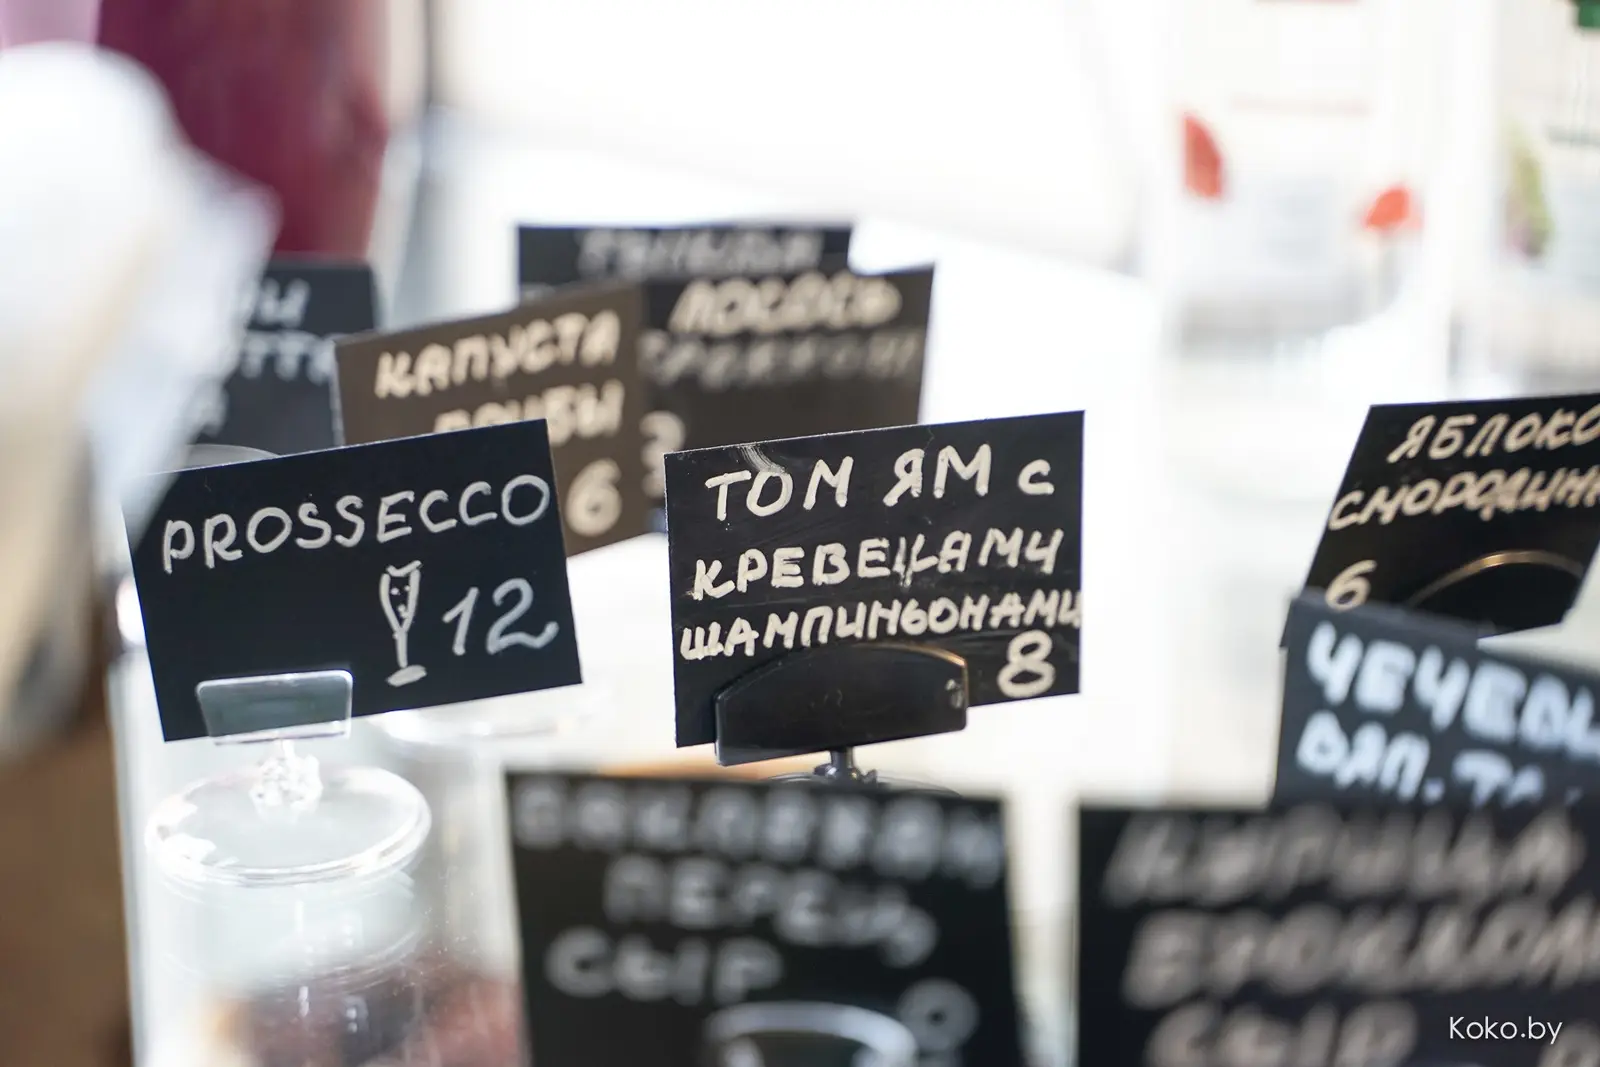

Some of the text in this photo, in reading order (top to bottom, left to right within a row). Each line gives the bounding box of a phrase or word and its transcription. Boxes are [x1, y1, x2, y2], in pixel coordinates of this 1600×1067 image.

[374, 309, 621, 399] КАПУСТА
[565, 456, 622, 537] 6
[705, 455, 854, 521] ТОМ
[883, 443, 993, 507] ЯМ
[163, 474, 550, 574] PROSSECCO
[442, 578, 559, 656] 12
[1325, 559, 1378, 612] 6
[997, 629, 1056, 698] 8
